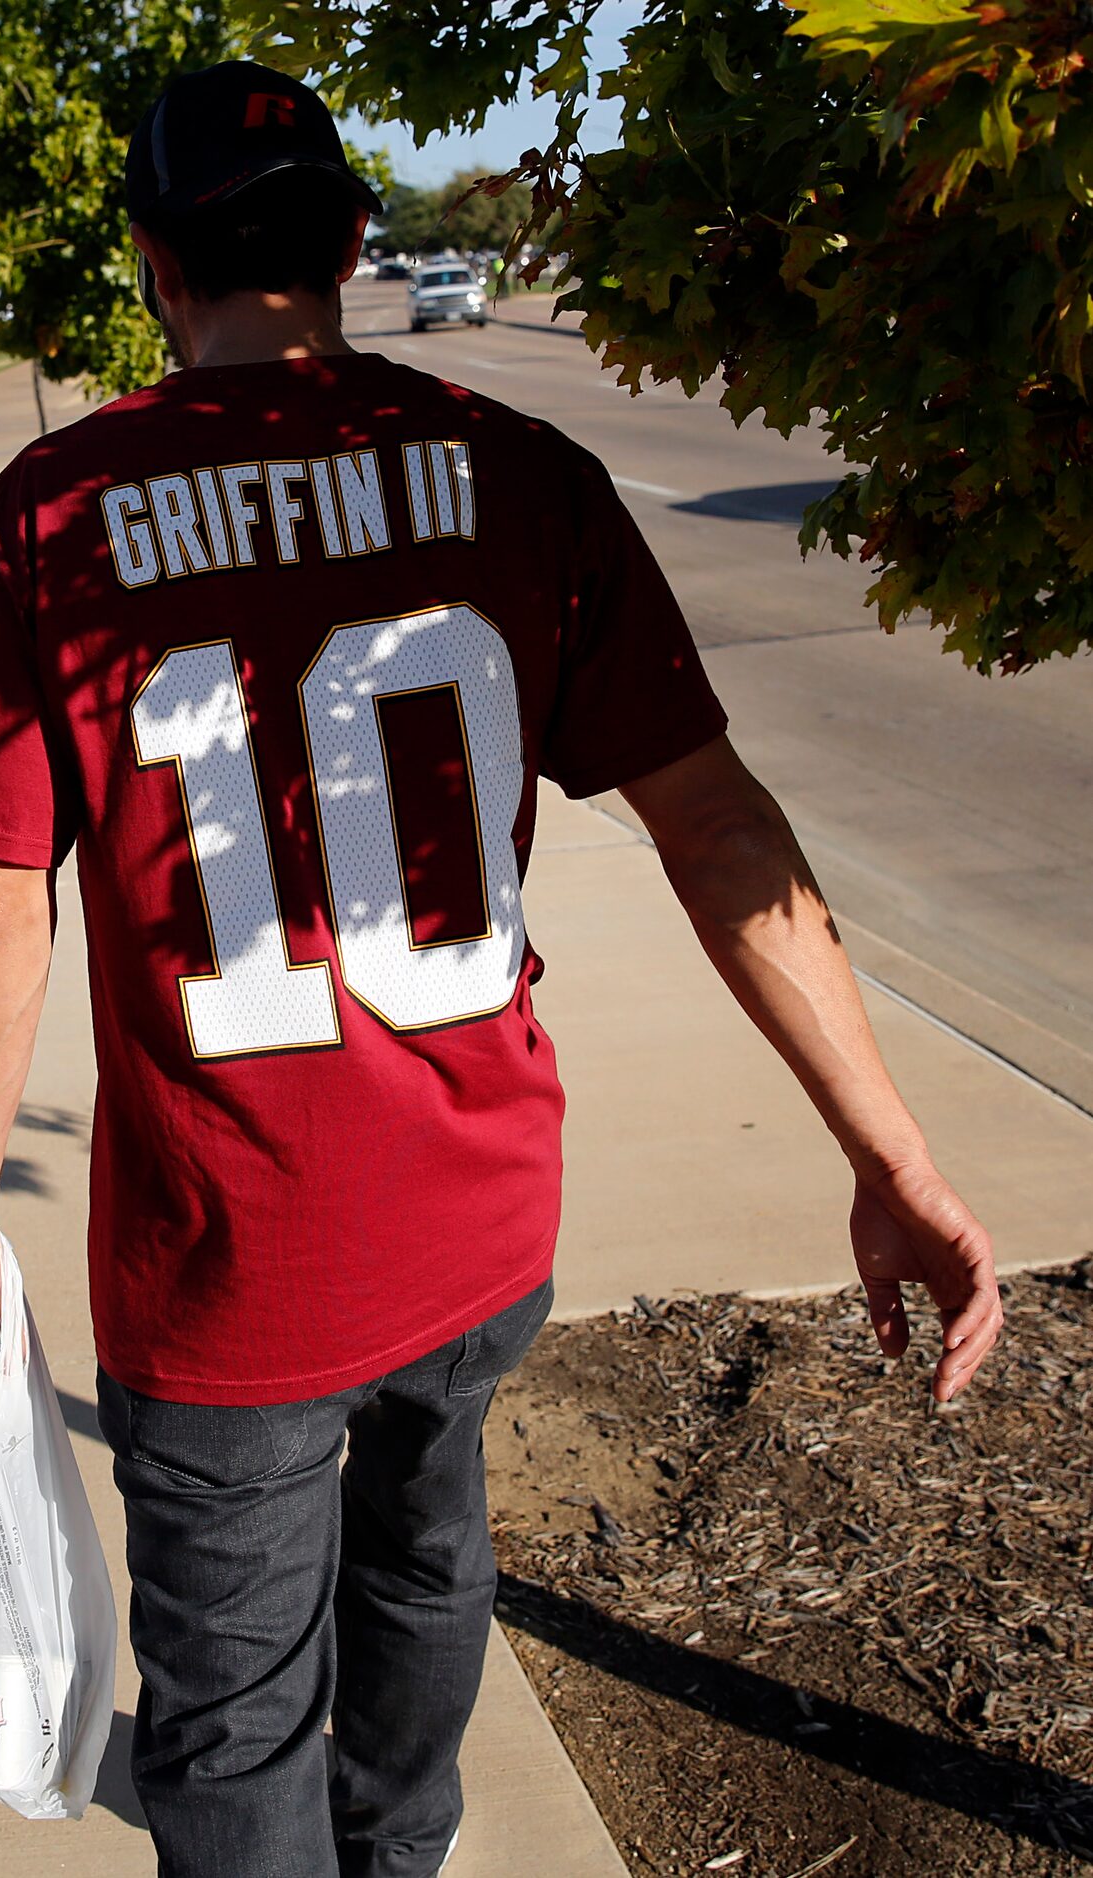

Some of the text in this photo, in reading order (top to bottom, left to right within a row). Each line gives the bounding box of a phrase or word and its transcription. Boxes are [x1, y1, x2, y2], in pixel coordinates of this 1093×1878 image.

[99, 440, 477, 591] GRIFFIN III
[129, 601, 525, 1060] 10
